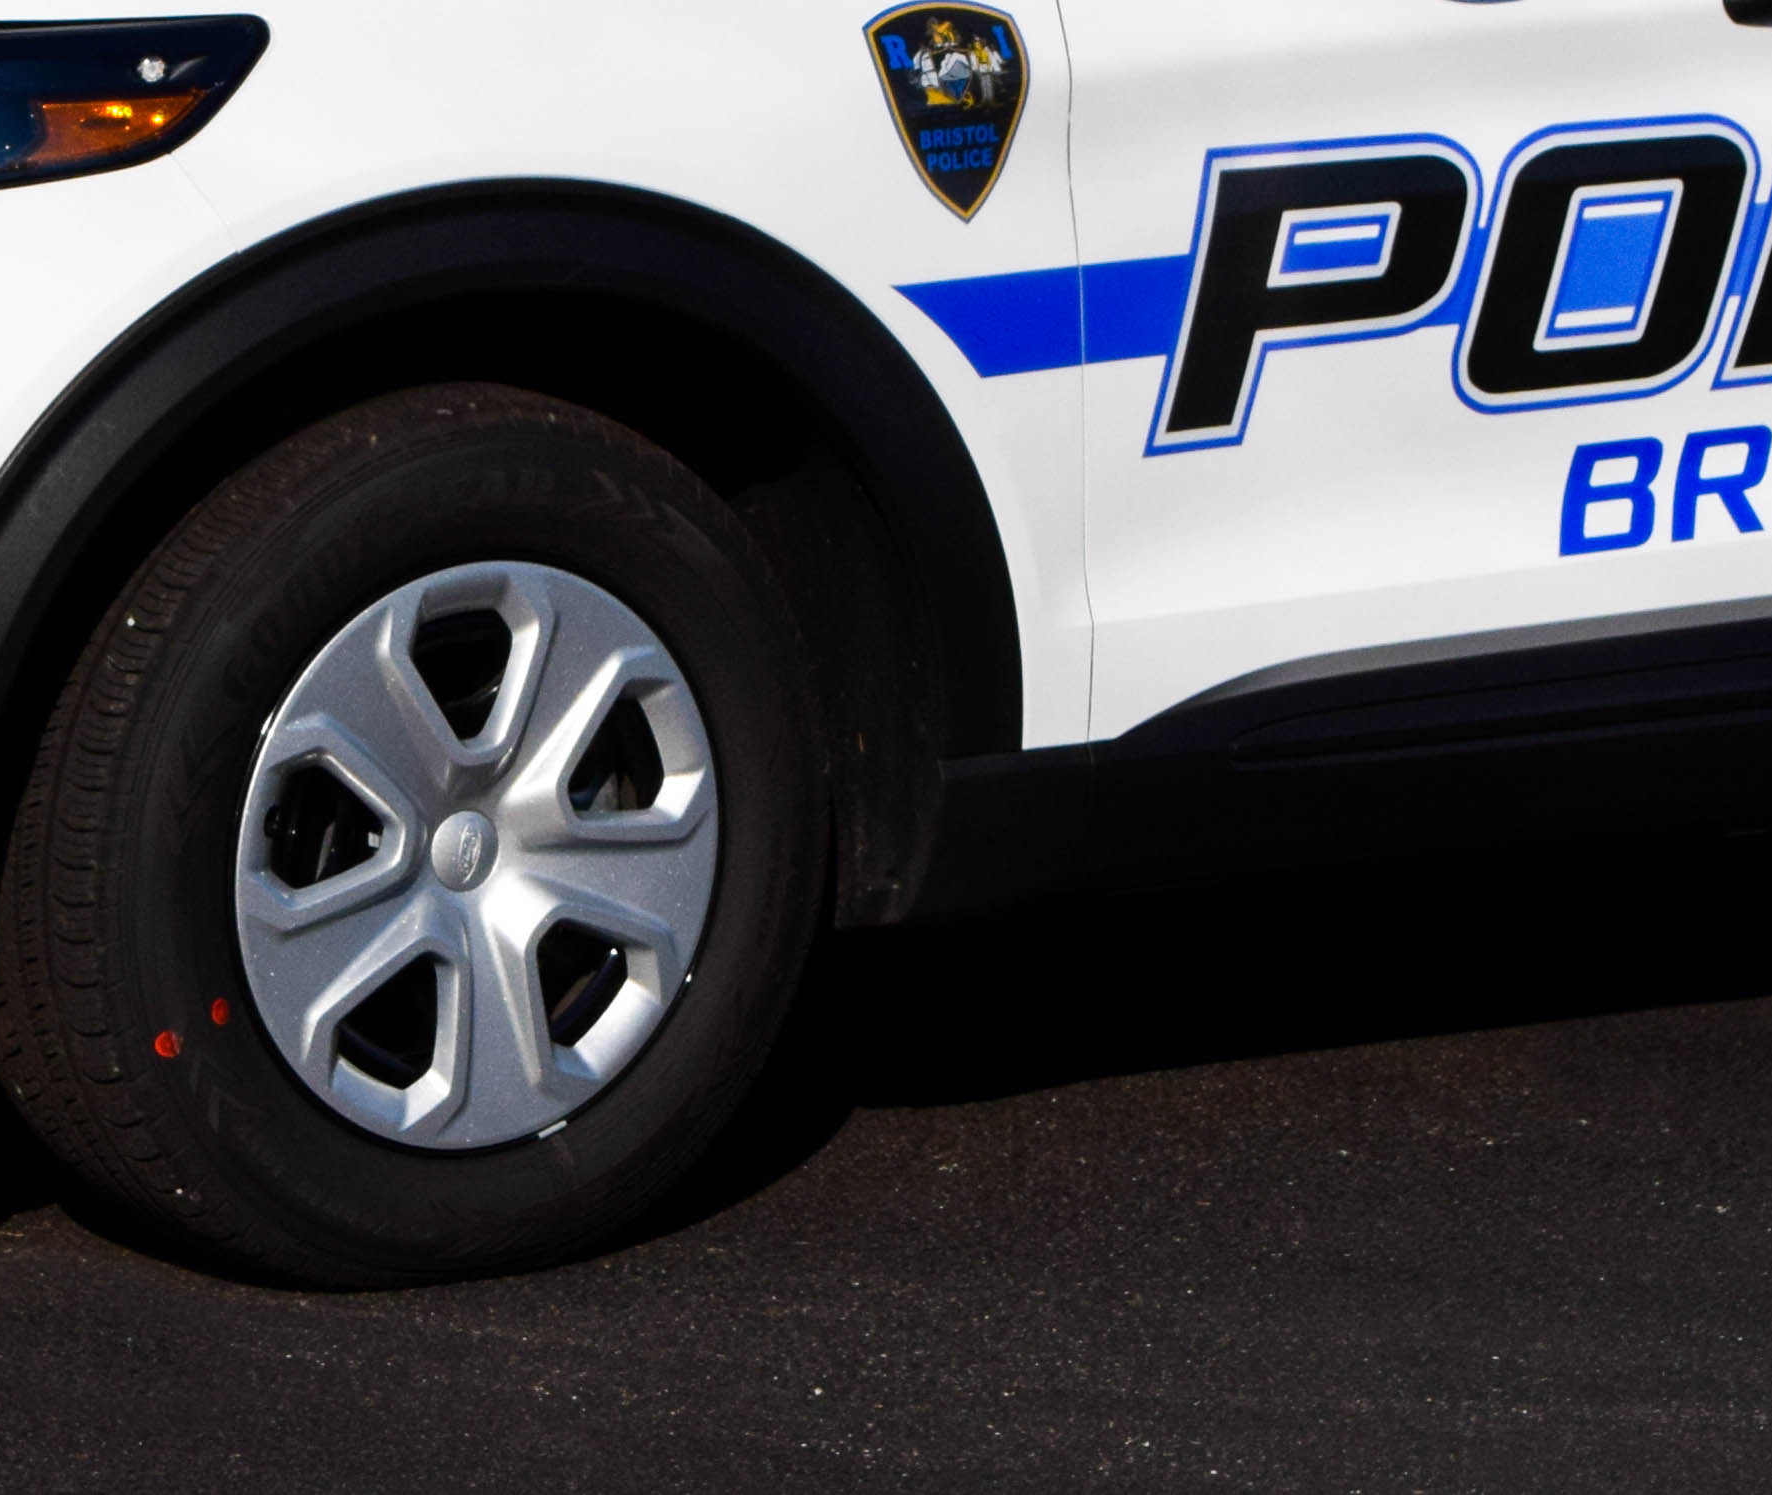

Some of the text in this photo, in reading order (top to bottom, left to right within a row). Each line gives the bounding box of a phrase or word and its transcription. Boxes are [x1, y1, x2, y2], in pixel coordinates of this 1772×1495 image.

[881, 24, 1012, 70] R I
[920, 123, 999, 150] BRISTOL
[927, 147, 994, 173] POLICE
